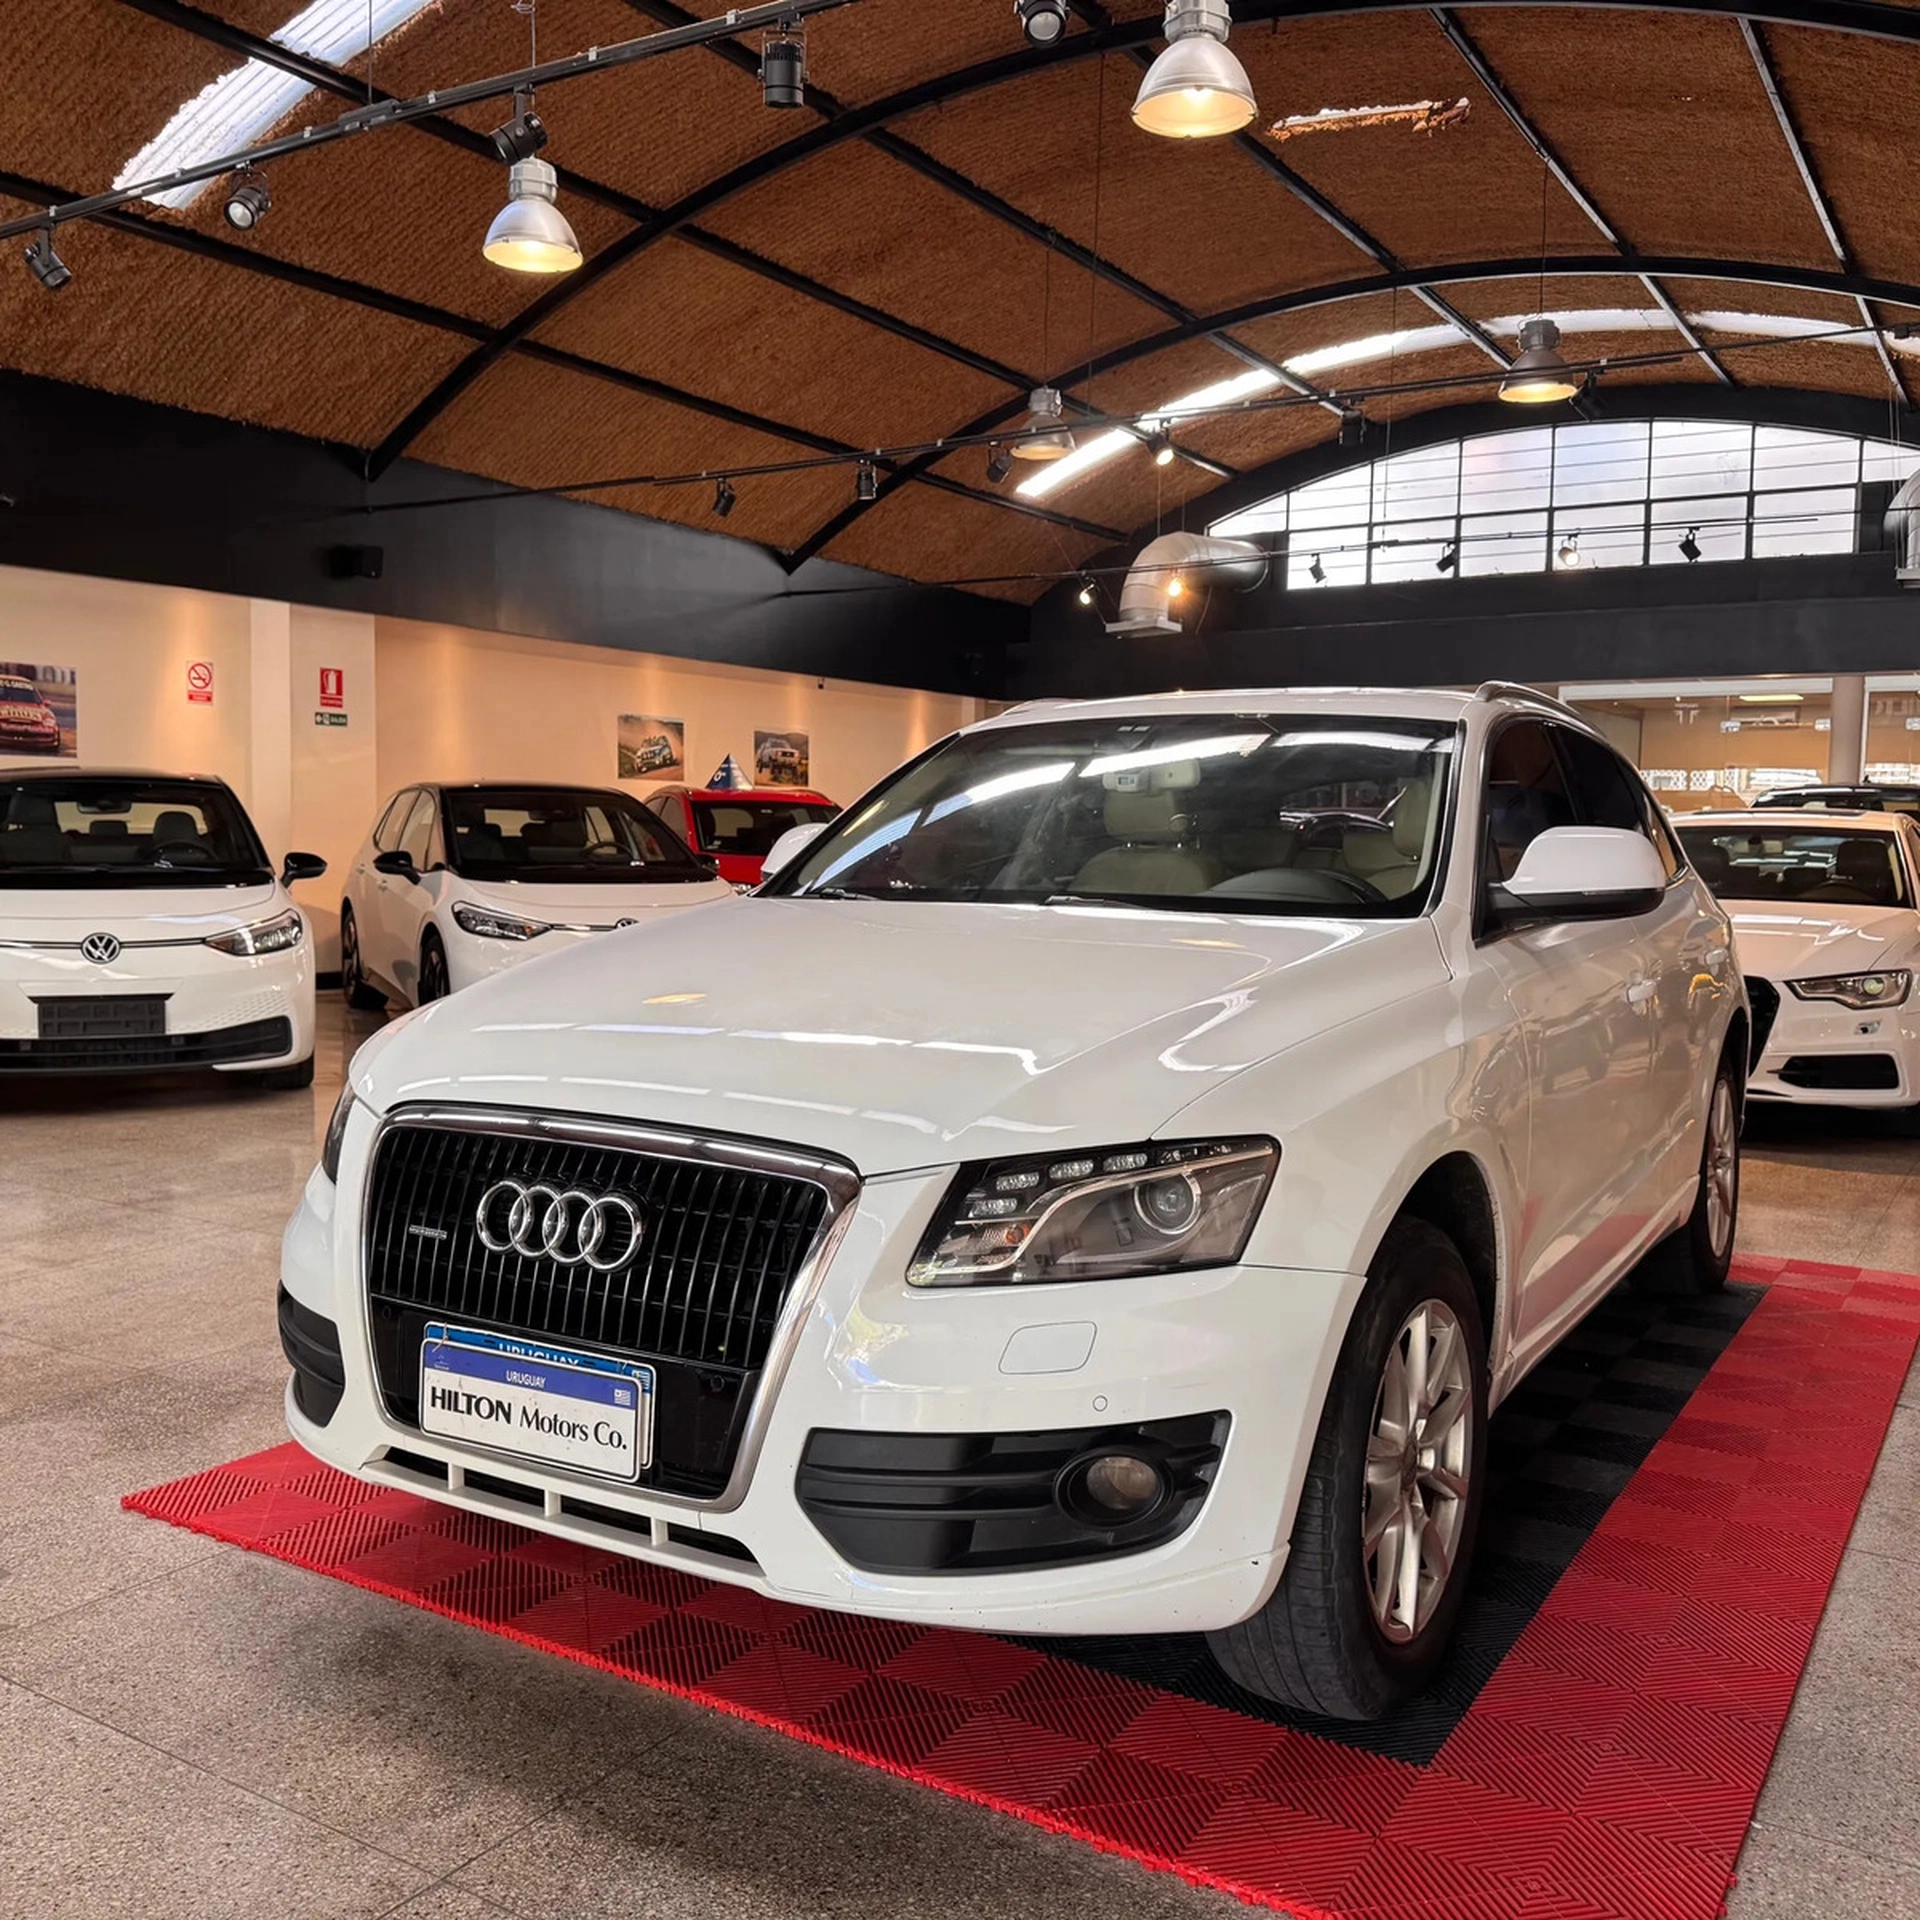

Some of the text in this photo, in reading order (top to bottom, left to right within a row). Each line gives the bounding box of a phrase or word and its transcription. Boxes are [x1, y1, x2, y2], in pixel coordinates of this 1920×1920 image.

[505, 1369, 547, 1388] URUGUAY
[431, 1386, 627, 1450] HILTON Motors Co.
